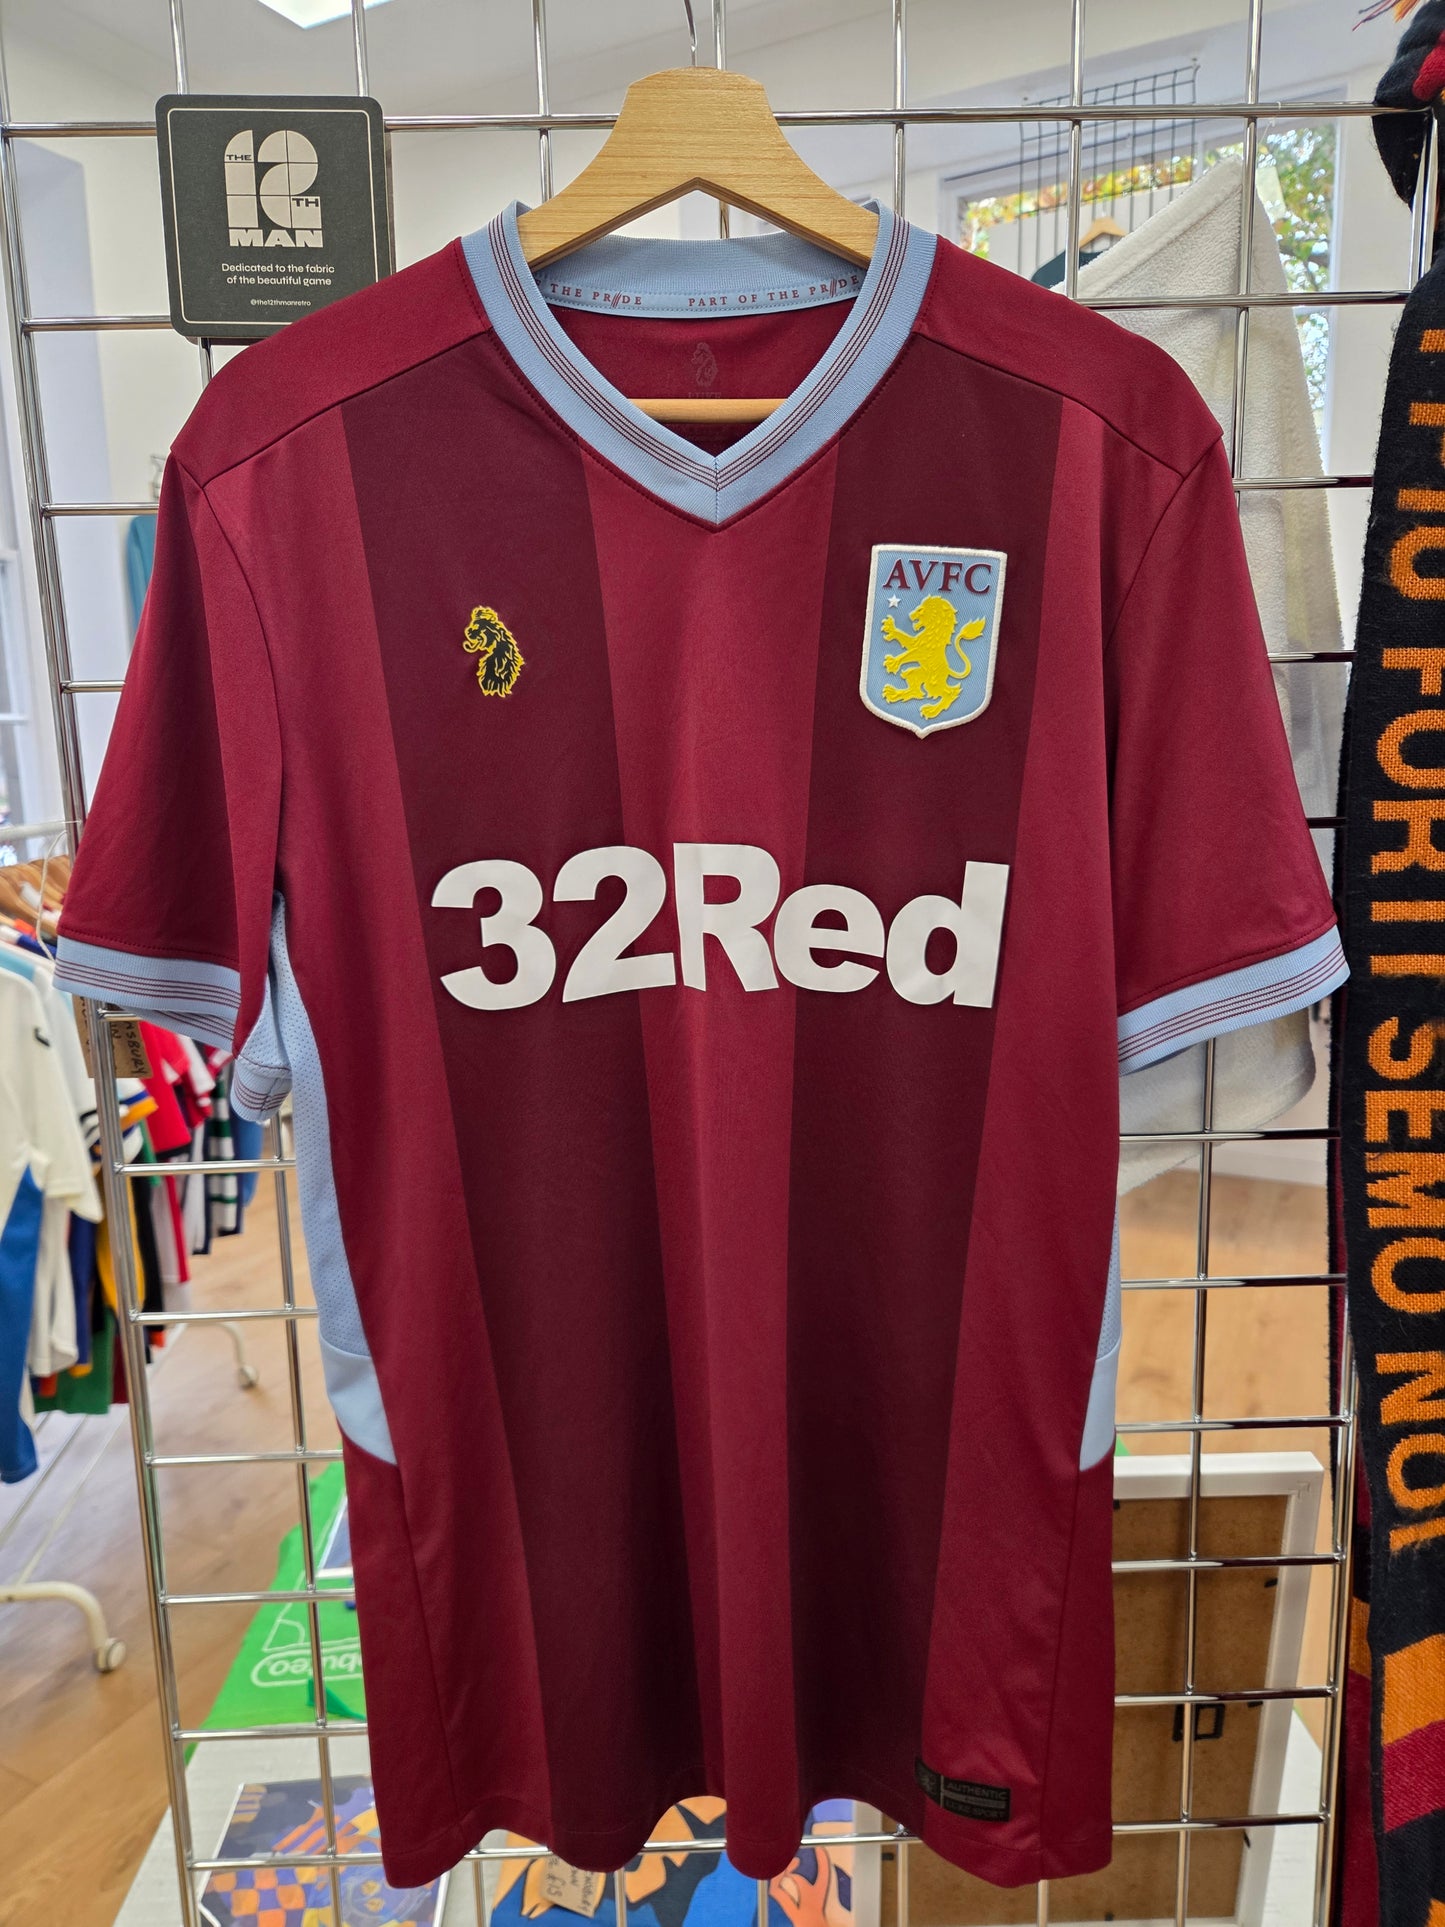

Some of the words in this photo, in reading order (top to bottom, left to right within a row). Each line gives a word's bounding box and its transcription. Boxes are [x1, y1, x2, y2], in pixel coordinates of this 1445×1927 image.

[291, 197, 319, 207] TH
[228, 228, 324, 248] MAN
[221, 263, 273, 273] Dedicated
[274, 263, 286, 273] to
[287, 263, 304, 273] the
[305, 263, 335, 274] fabric
[226, 275, 238, 285] of
[239, 276, 256, 285] the
[257, 275, 301, 286] beautiful
[302, 277, 332, 287] game
[550, 283, 583, 298] THE
[688, 296, 728, 307] PART
[738, 294, 759, 304] OF
[767, 289, 800, 301] THE
[250, 299, 312, 307] @the12thmanretro
[882, 558, 992, 595] AVFC
[431, 842, 1010, 1011] 32Red
[946, 1782, 1008, 1800] AUTHENTIC
